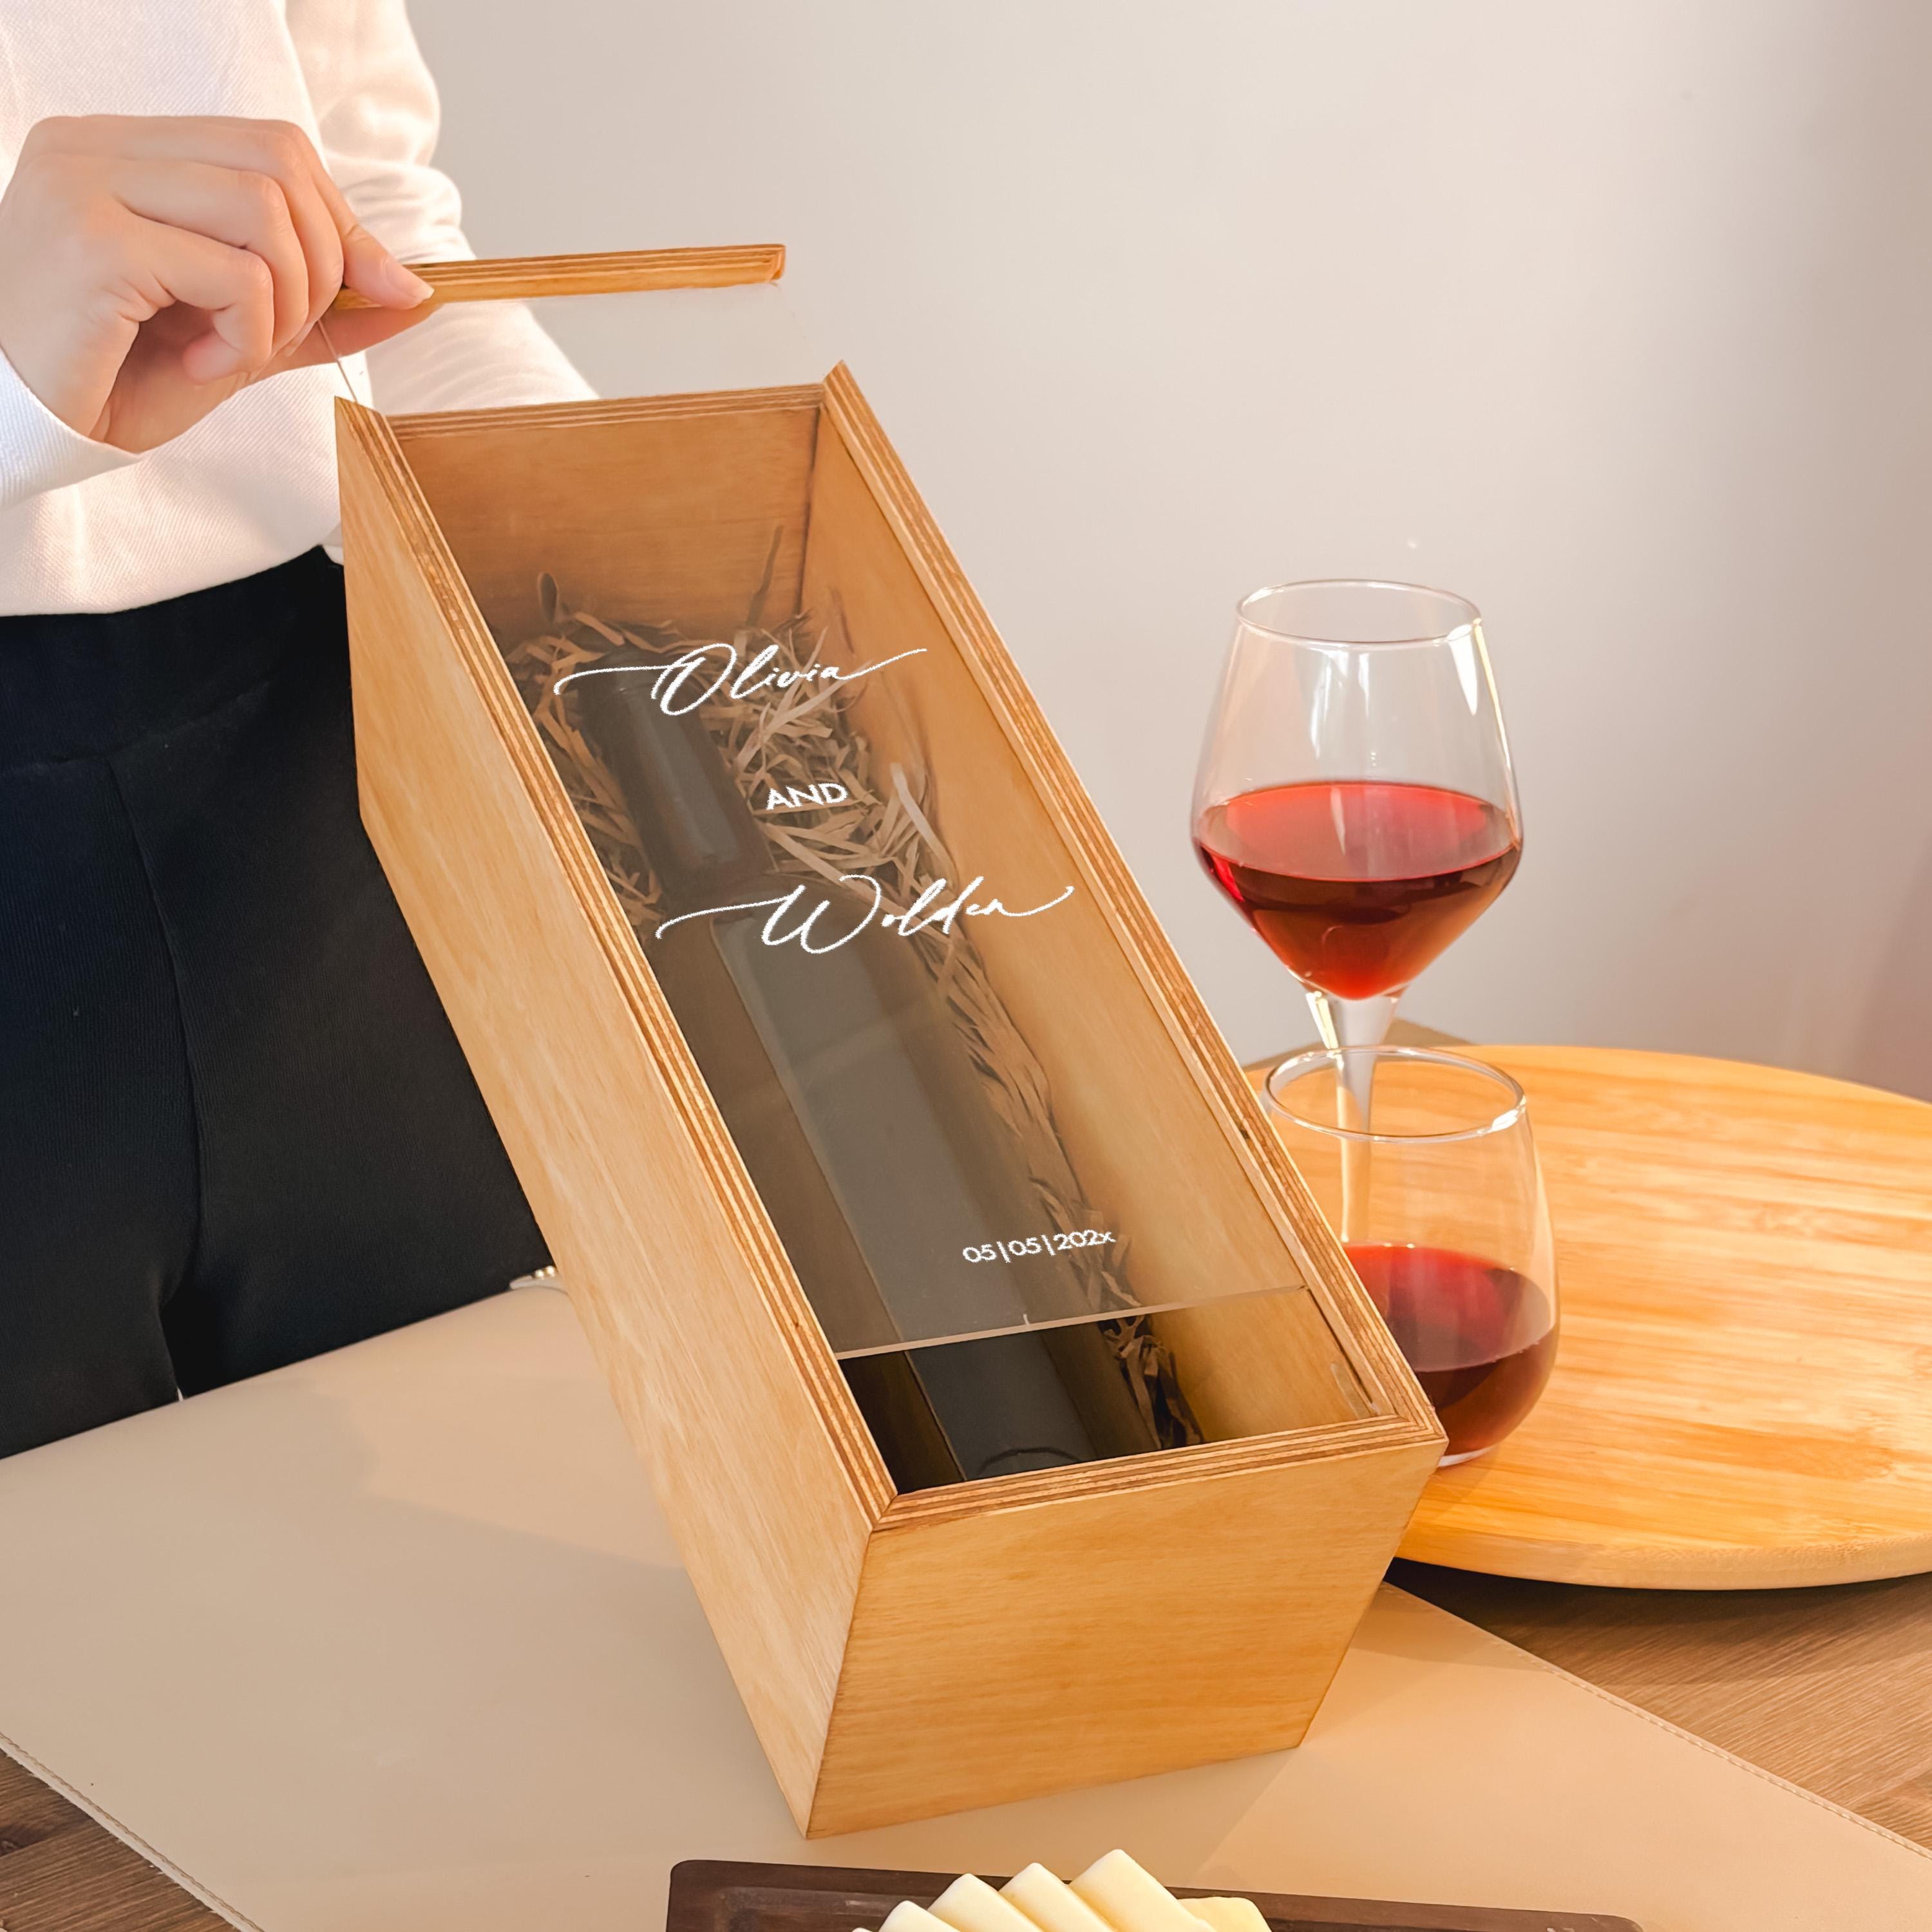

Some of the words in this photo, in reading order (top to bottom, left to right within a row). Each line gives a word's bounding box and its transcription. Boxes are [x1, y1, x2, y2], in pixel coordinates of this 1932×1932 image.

[553, 643, 927, 716] Olivia
[766, 782, 849, 810] AND
[654, 874, 1074, 954] Wolden
